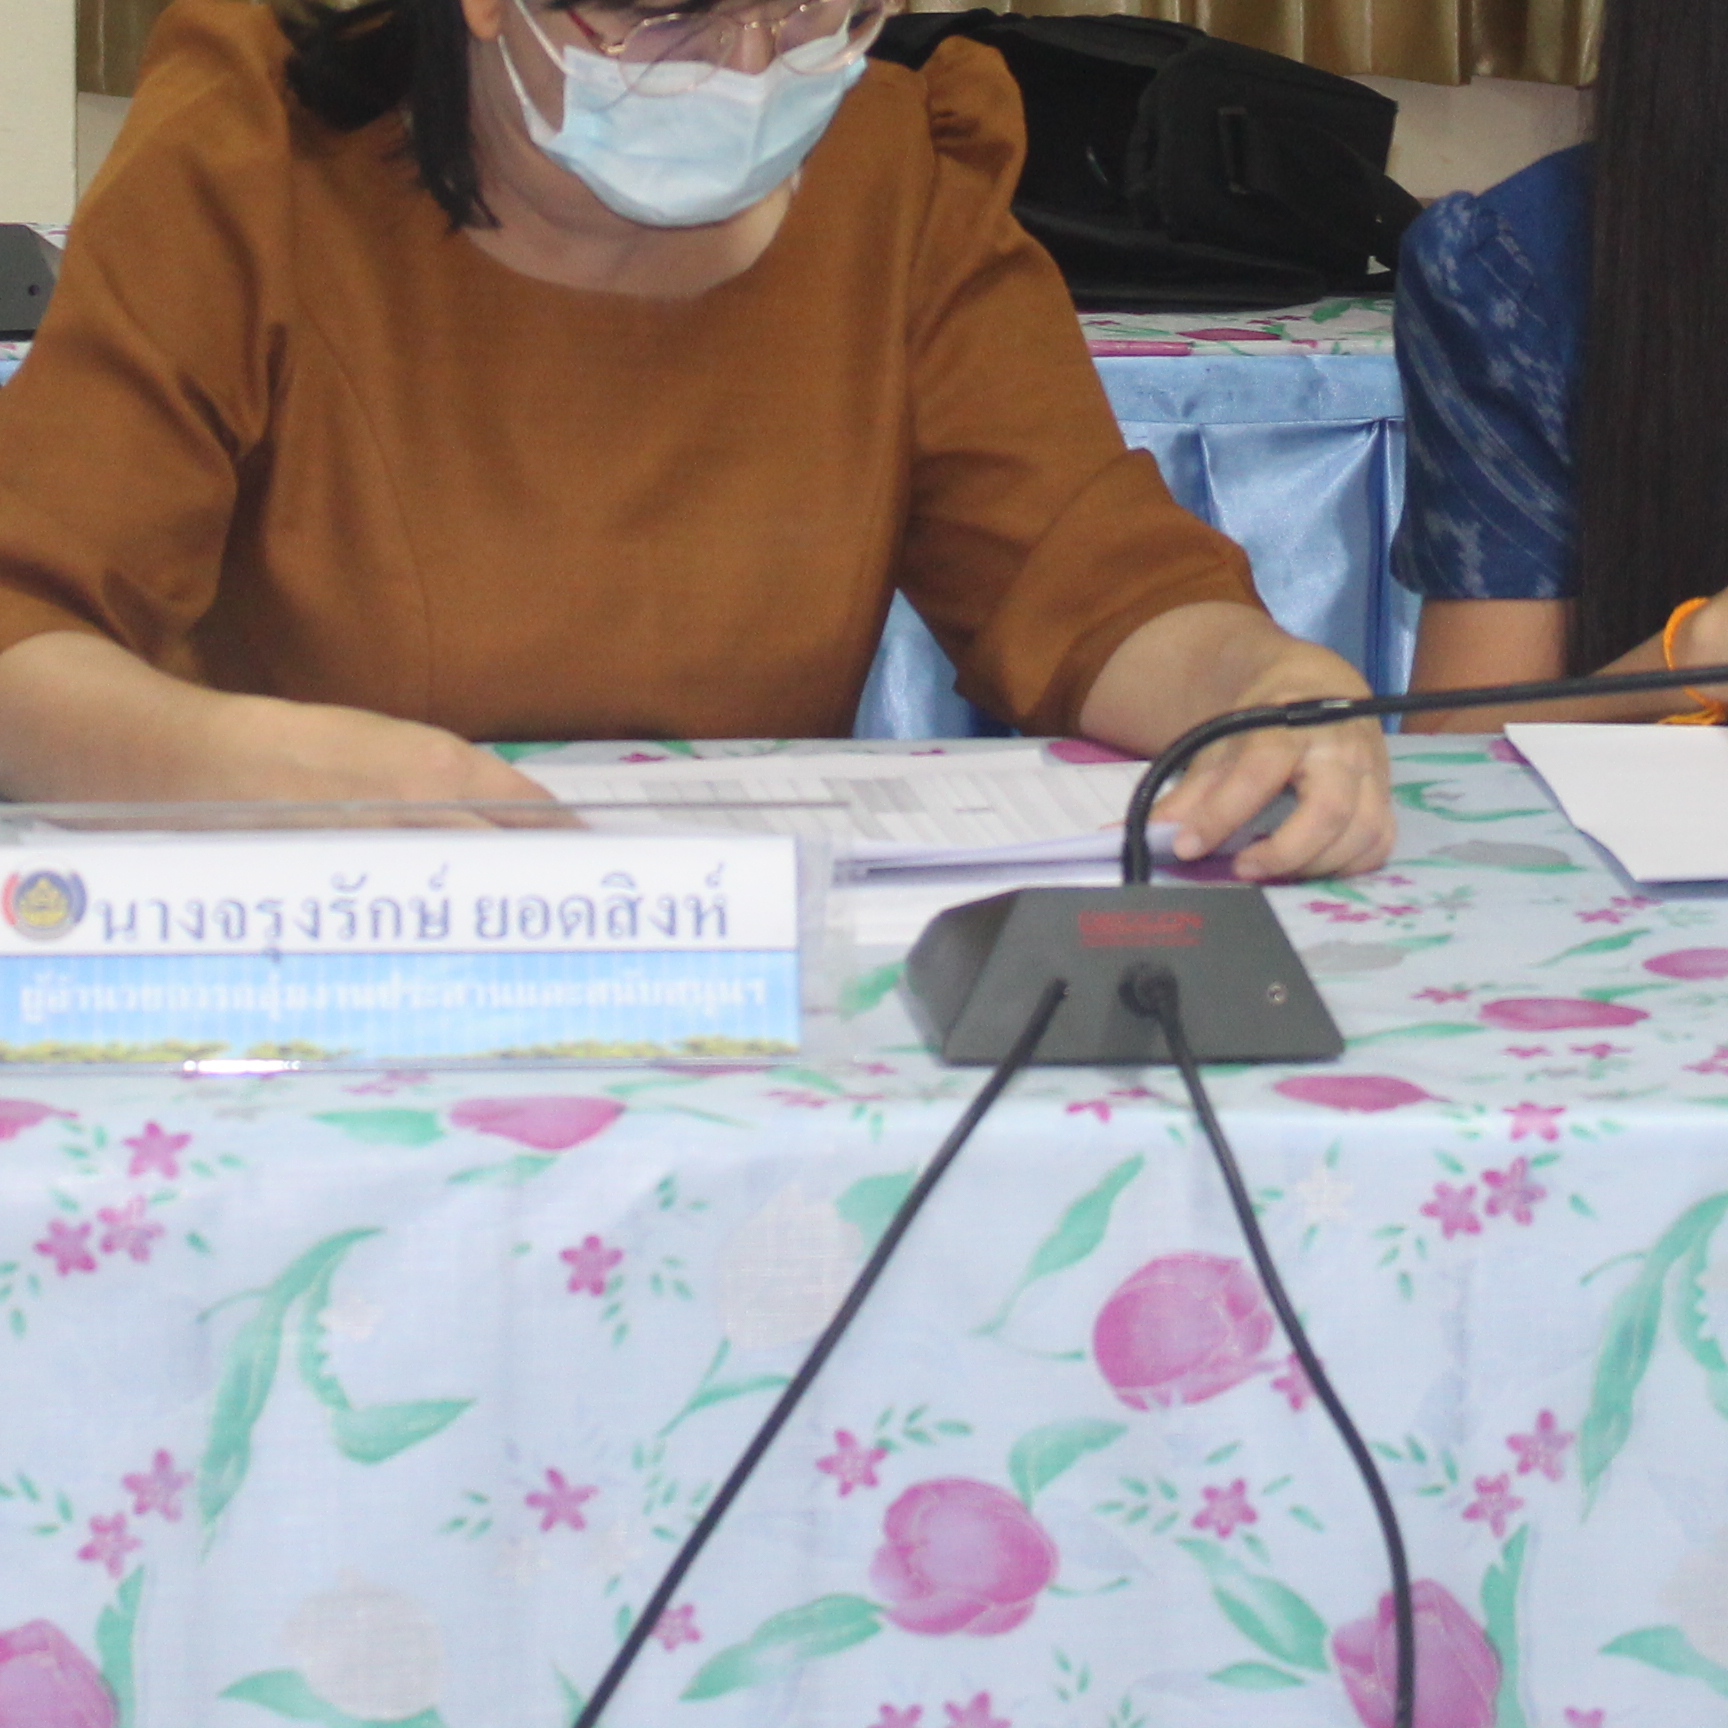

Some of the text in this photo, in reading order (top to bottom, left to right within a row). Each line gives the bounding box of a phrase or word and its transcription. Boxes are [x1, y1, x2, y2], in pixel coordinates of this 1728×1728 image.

[94, 861, 728, 964] นางจรุงรักษ์ ยอดสิงห์
